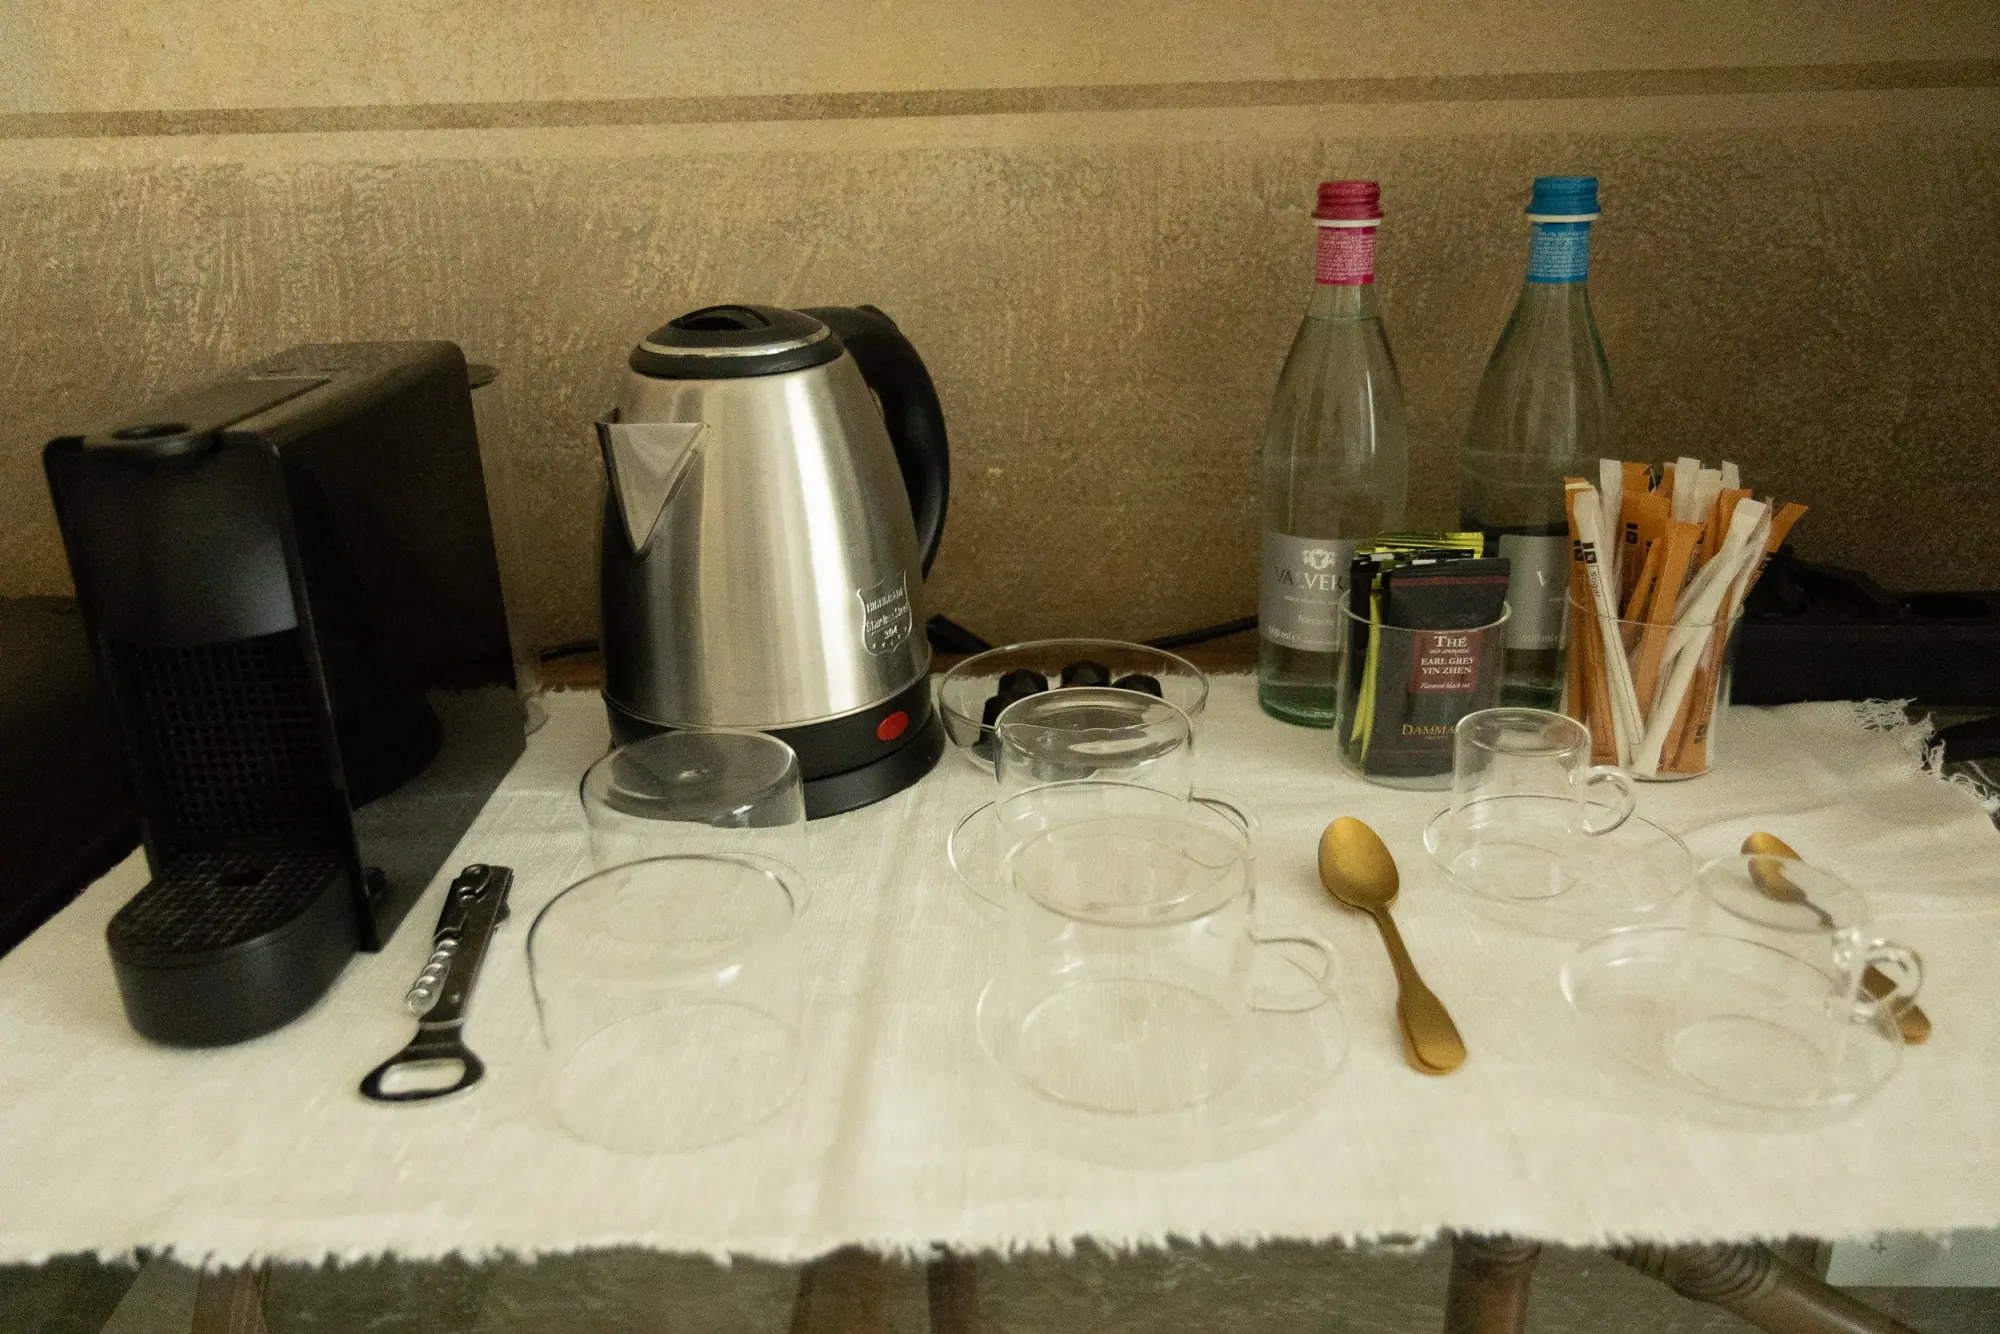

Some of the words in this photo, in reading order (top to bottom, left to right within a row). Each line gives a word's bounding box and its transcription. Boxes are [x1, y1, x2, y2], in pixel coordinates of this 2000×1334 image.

[1590, 571, 1601, 598] Sugar
[884, 625, 898, 639] 304
[1421, 657, 1447, 665] EARL
[1448, 656, 1475, 665] GREY
[1442, 666, 1472, 674] ZHEN
[1401, 724, 1454, 735] DAMMA
